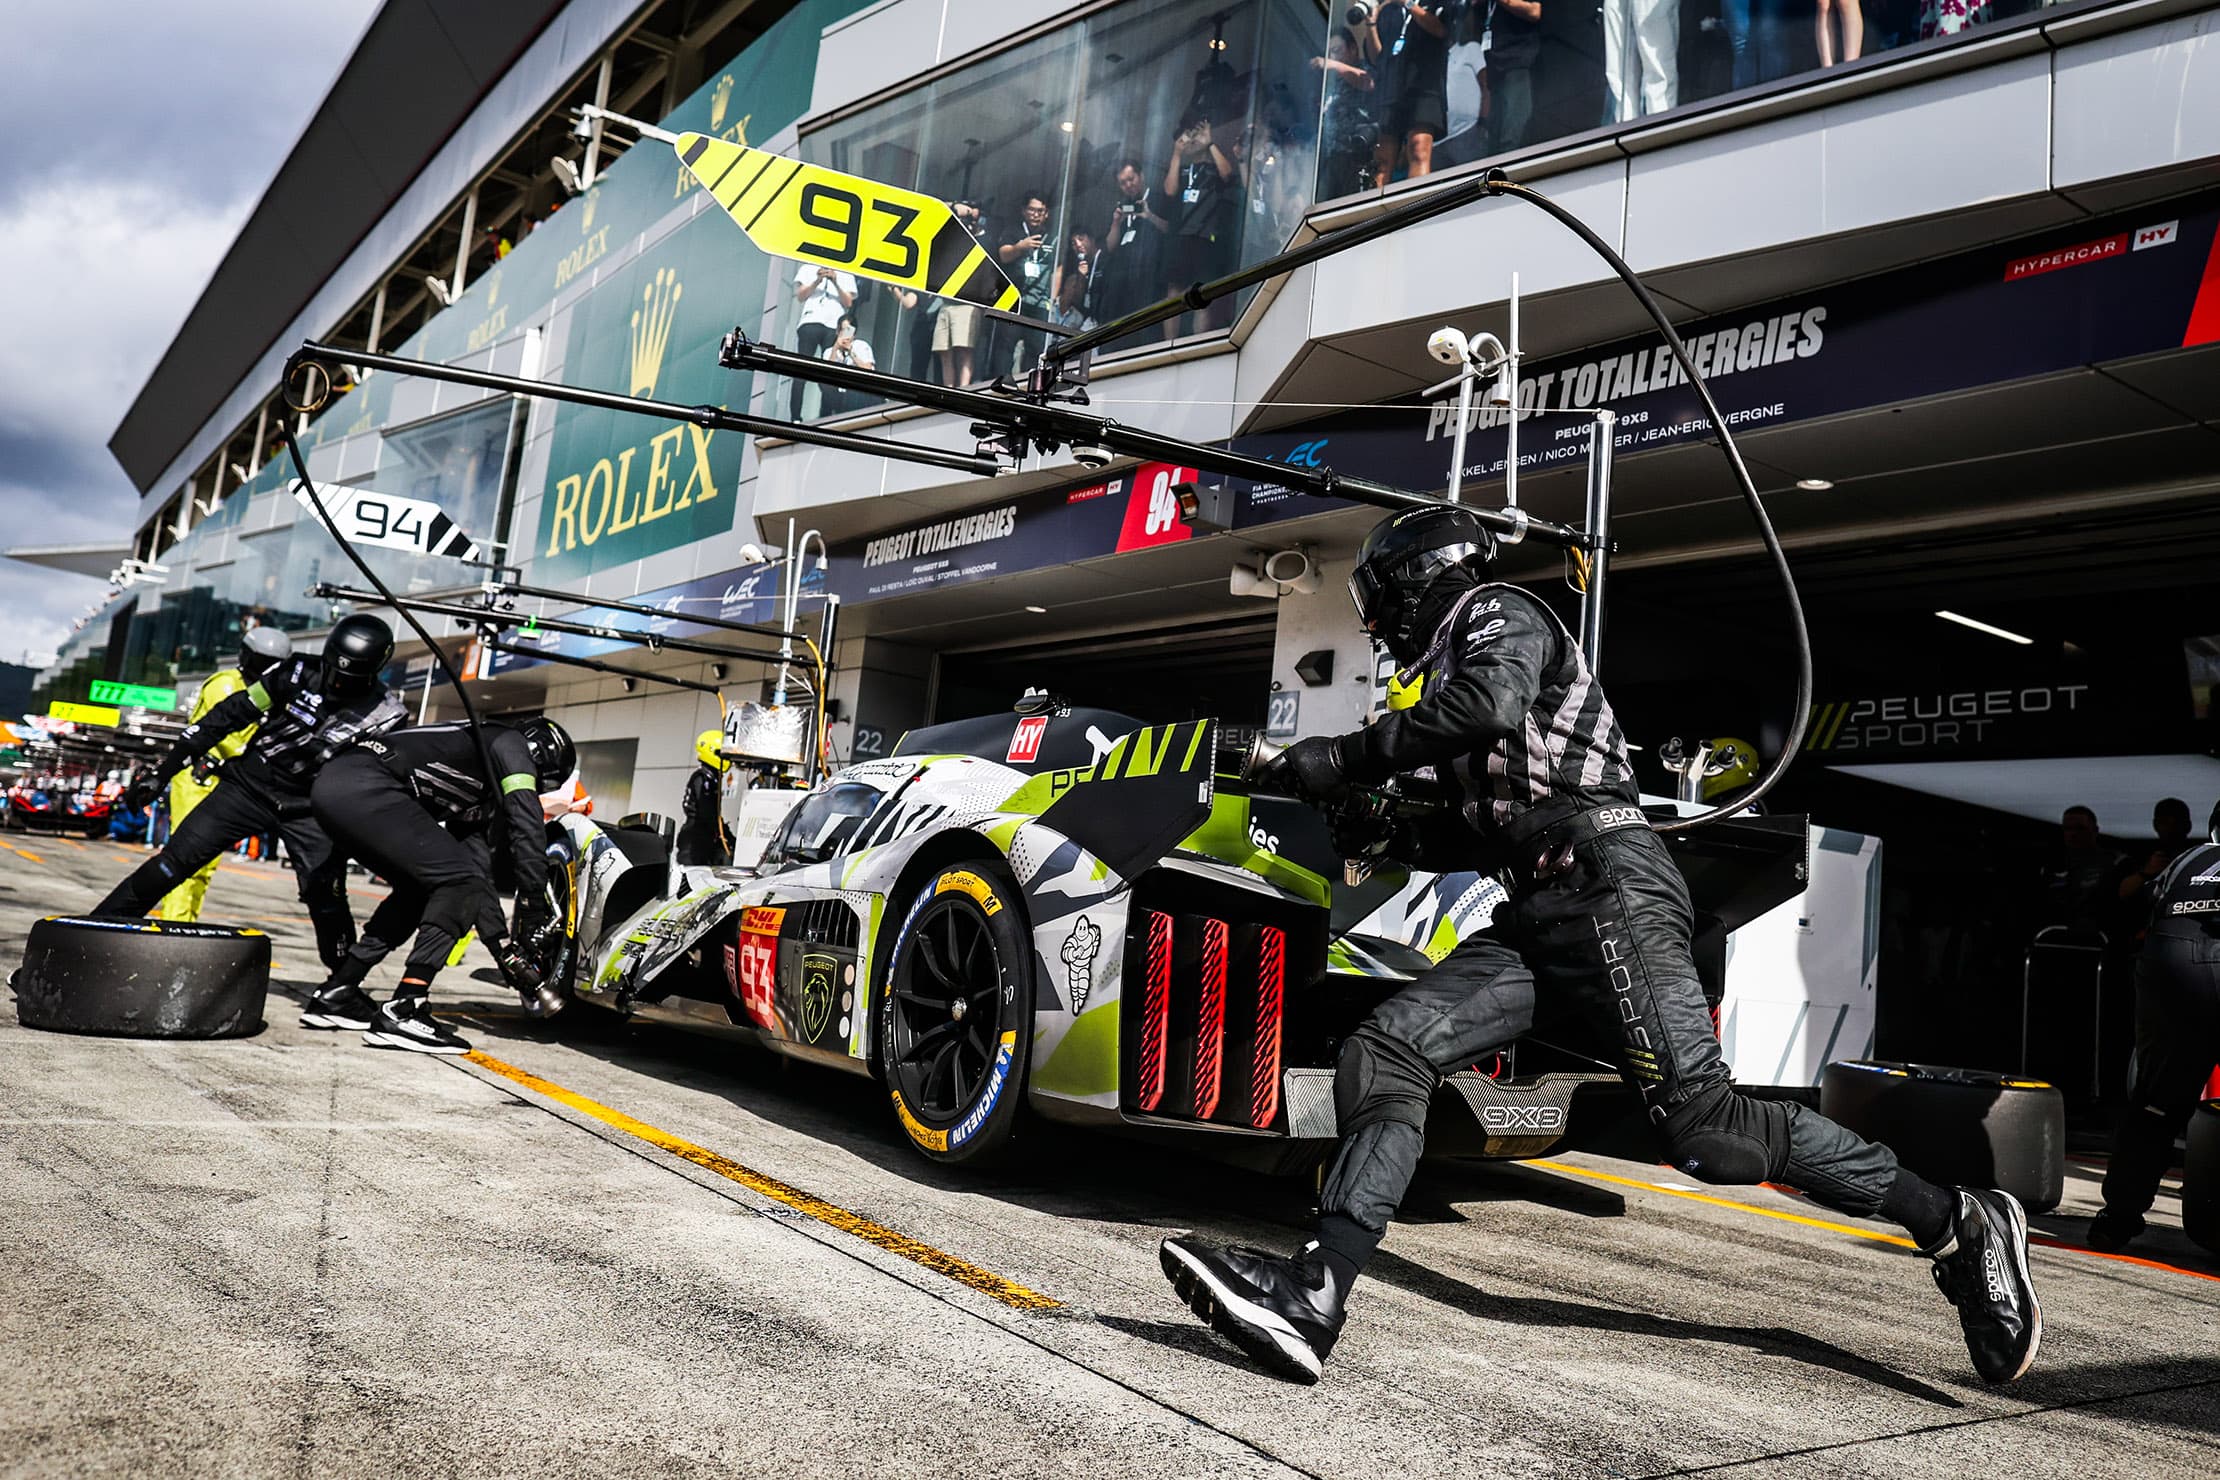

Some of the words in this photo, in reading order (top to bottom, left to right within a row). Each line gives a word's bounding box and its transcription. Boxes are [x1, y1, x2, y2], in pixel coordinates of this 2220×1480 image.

[796, 182, 920, 278] 93
[2140, 227, 2170, 244] HY
[555, 224, 610, 288] ROLEX
[2014, 241, 2117, 275] HYPERCAR
[1545, 446, 1577, 461] NICO
[1721, 403, 1784, 425] VERGNE
[1621, 411, 1649, 426] 9X8
[545, 405, 728, 558] ROLEX
[1145, 467, 1182, 535] 94
[355, 500, 422, 545] 94
[863, 531, 917, 568] PEUGEOT
[916, 506, 1017, 556] TOTALENERGIES
[722, 576, 760, 605] WEC
[1269, 698, 1297, 730] 22
[1851, 685, 2088, 723] PEUGEOT
[856, 730, 883, 754] 22
[1011, 725, 1043, 754] HY
[1837, 719, 1994, 750] SPORT
[956, 876, 975, 888] SPORT
[983, 895, 997, 911] M
[741, 944, 772, 1016] 93
[1593, 916, 1652, 1050] SPORT
[952, 1067, 1003, 1145] MICHELIN
[1483, 1106, 1562, 1128] 9X8
[1985, 1249, 2005, 1302] sparco
